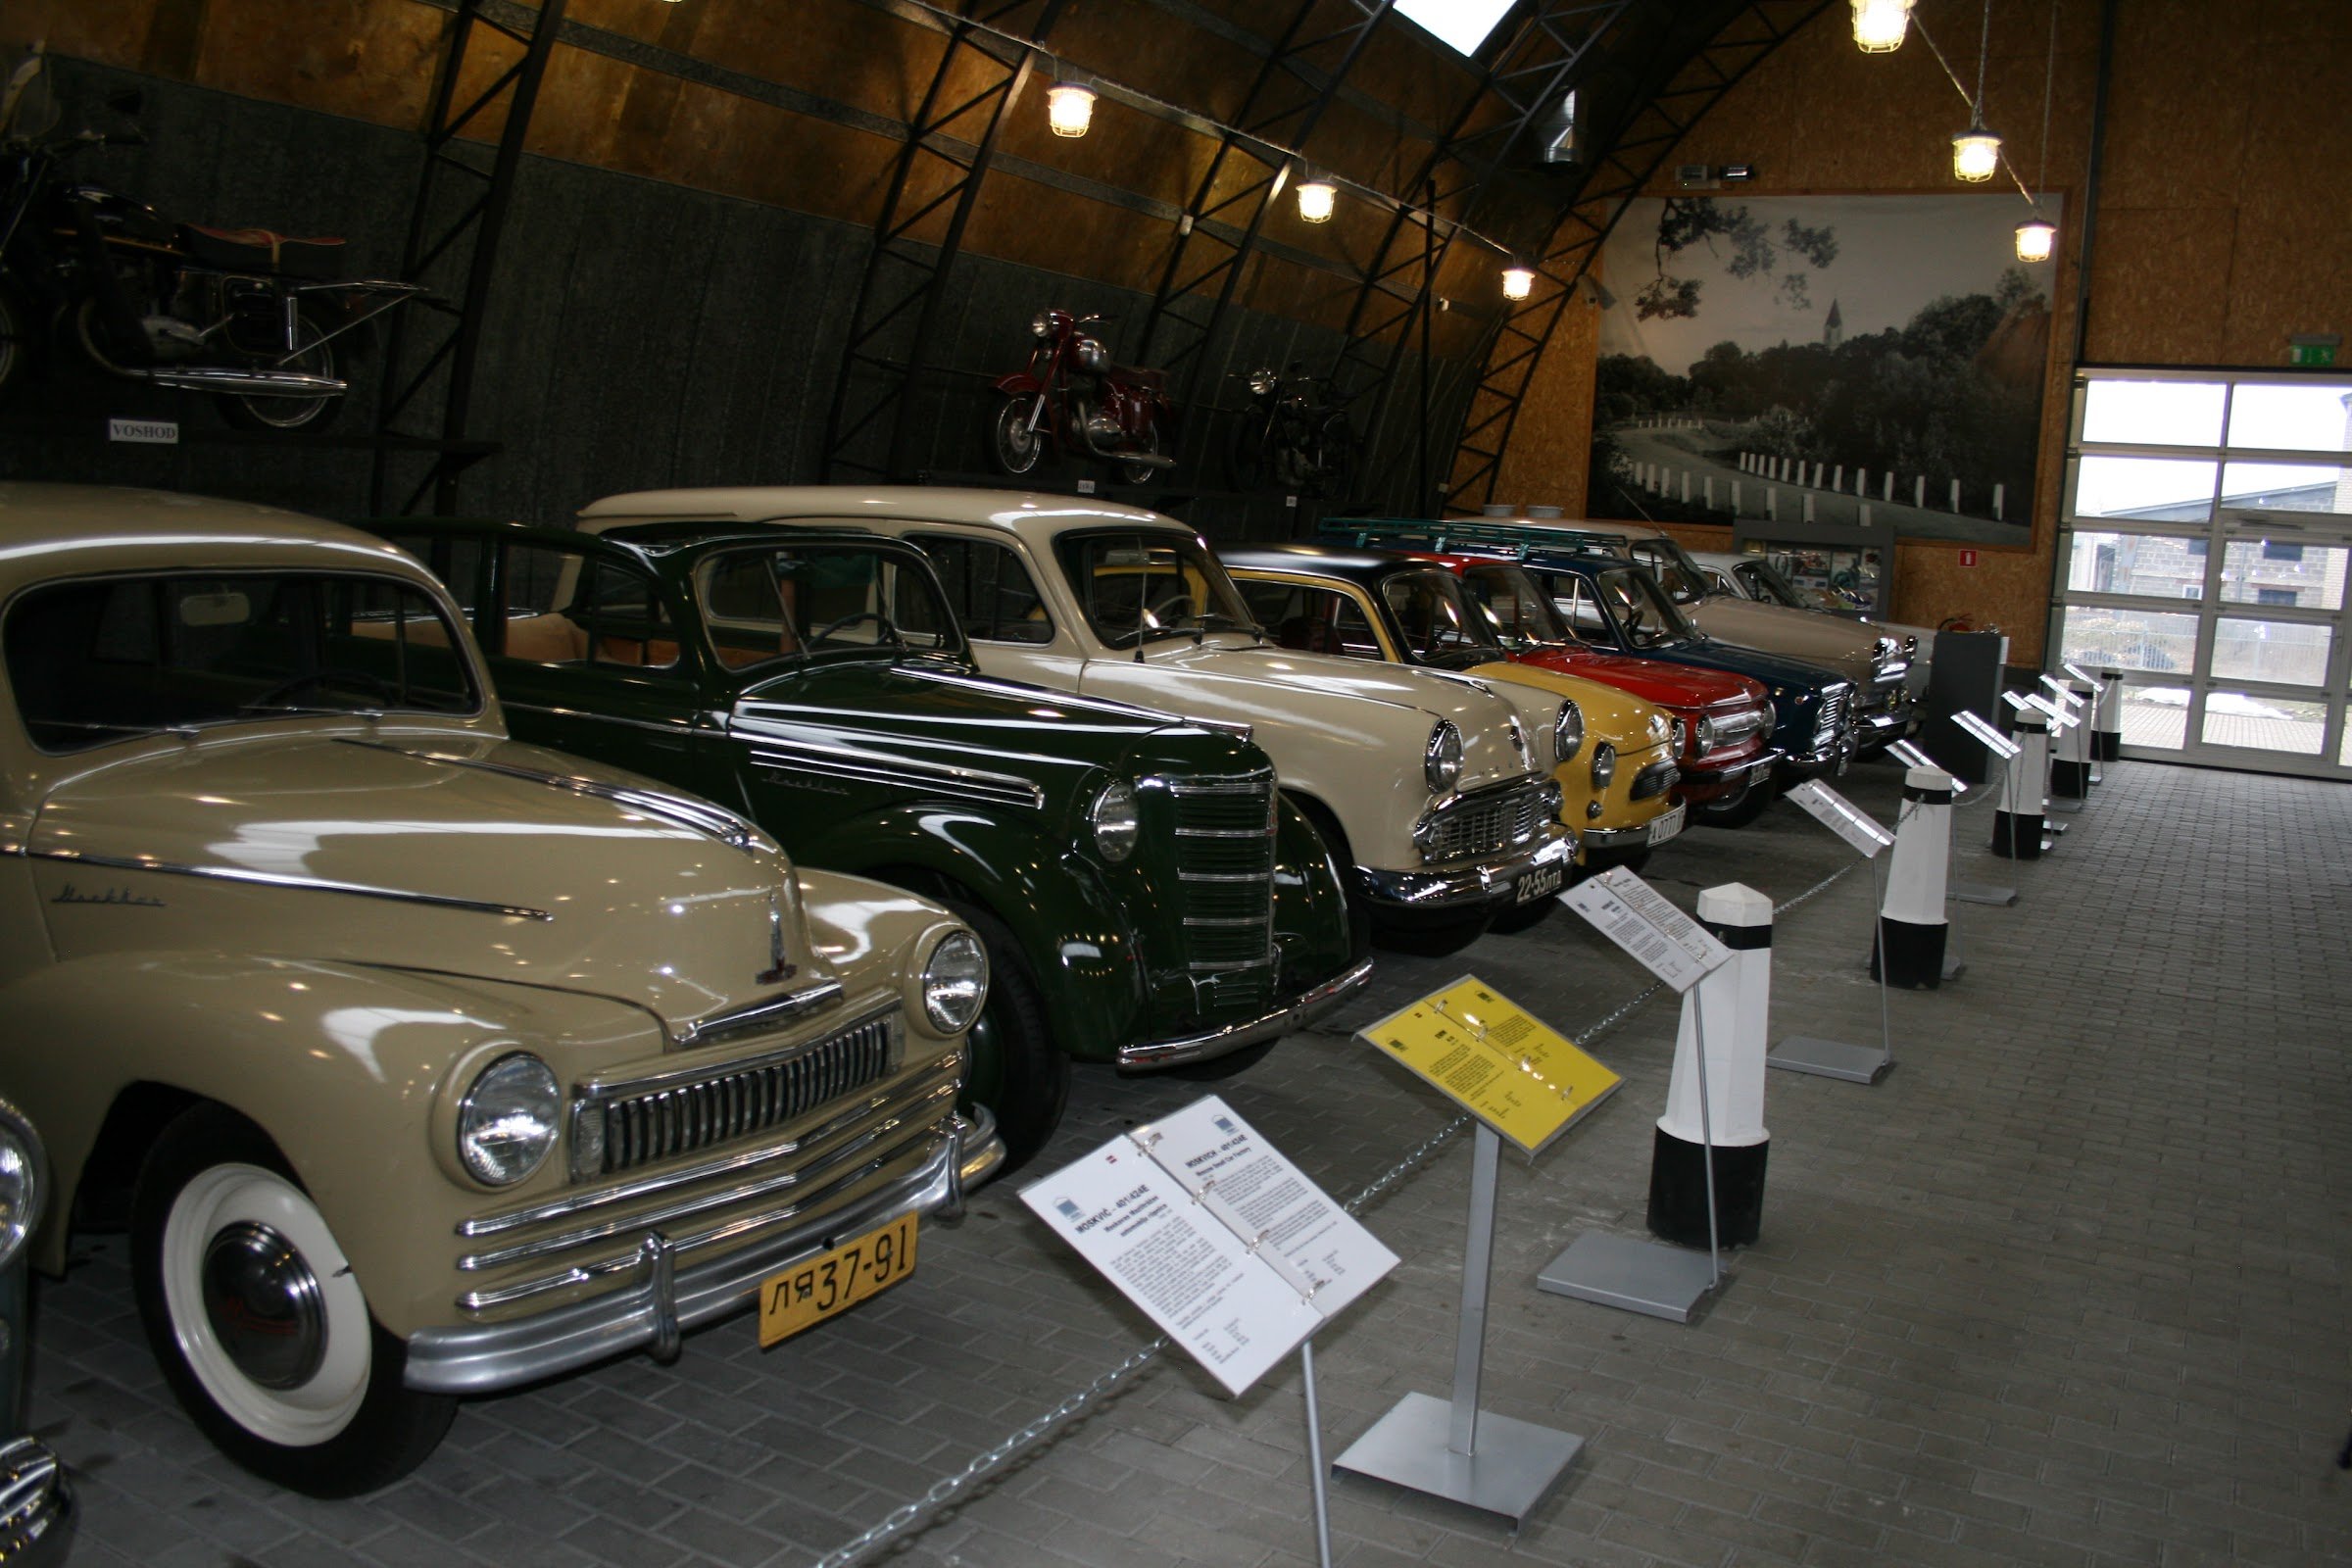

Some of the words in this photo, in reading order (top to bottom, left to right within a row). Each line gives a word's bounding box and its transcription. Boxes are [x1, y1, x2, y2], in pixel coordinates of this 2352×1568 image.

[112, 422, 176, 439] VOSHOD
[1075, 1207, 1112, 1234] MOSKVIČ
[1115, 1184, 1151, 1208] 401/424E
